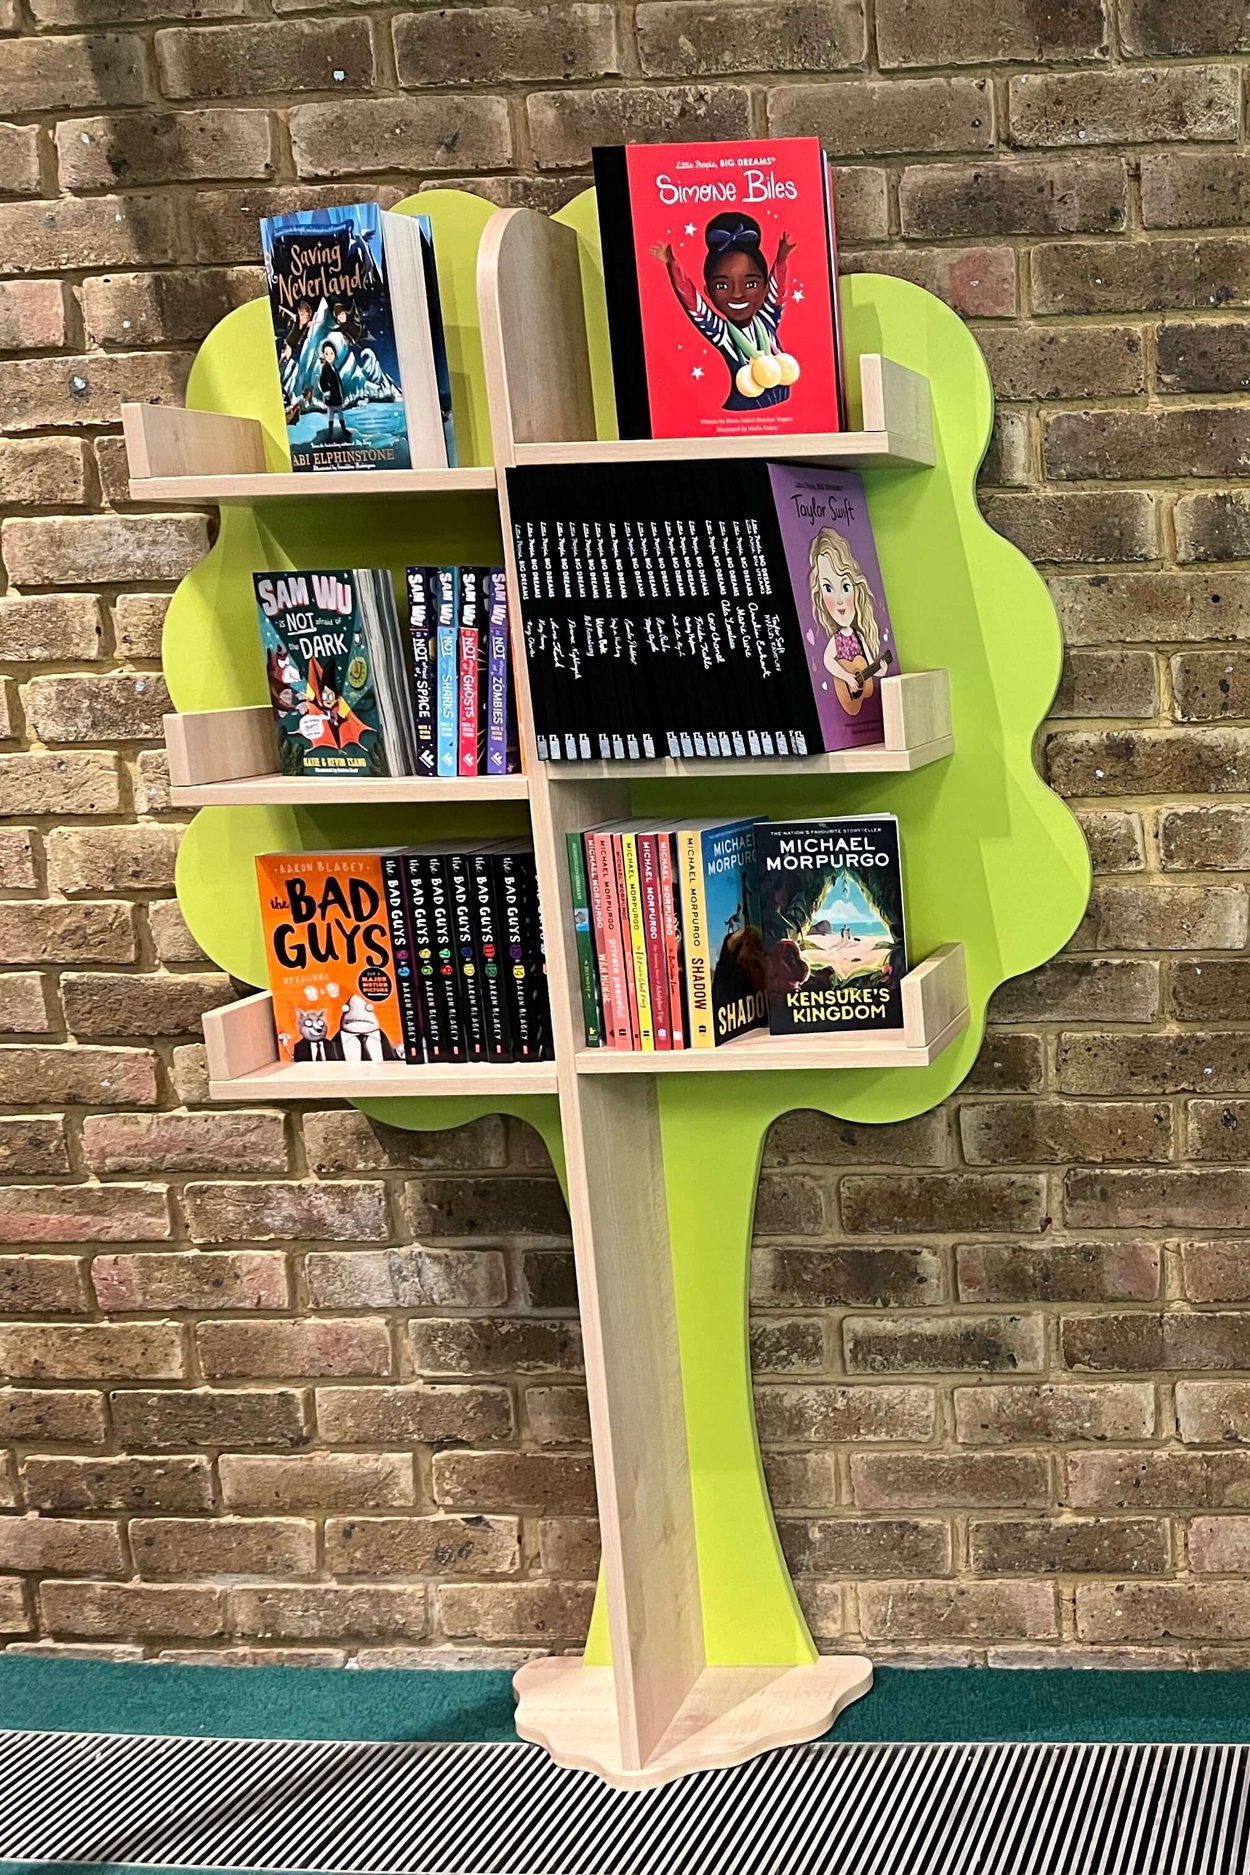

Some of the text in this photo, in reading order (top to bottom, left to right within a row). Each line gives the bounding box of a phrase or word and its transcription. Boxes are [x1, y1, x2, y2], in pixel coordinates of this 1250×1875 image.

[720, 158, 734, 167] BIG
[656, 170, 798, 205] Simone Biles
[290, 243, 343, 277] Saving
[279, 263, 363, 306] Neverland
[292, 449, 394, 466] ABI ELPHINSTONE
[791, 494, 854, 526] Taylor Swift
[258, 574, 352, 616] SAM WU
[408, 574, 426, 626] SAM WU
[462, 573, 476, 626] SAM WU
[491, 573, 506, 625] SAM WU
[286, 612, 316, 633] NOT
[736, 606, 752, 658] Marie Curie
[300, 632, 349, 660] DARK
[414, 638, 431, 718] NOT SPACE
[463, 637, 476, 718] NOT GHOSTS
[492, 636, 505, 724] NOT ZOMBIES
[280, 862, 364, 873] AARON BLABEY
[767, 853, 890, 870] MORPURGO
[780, 837, 875, 854] MICHAEL
[271, 876, 380, 924] the BAD
[386, 861, 406, 945] the BAD GUYS
[430, 859, 449, 944] the BAD GUYS
[600, 840, 614, 930] MICHAEL MORPURGO
[274, 918, 390, 970] GUYS
[687, 837, 707, 1010] MICHAEL MORPURGO SHADOW
[608, 939, 625, 1017] private peaceful
[786, 988, 890, 1007] KENSUKE'S
[402, 982, 416, 1042] AARON BLABEY
[718, 990, 767, 1035] SHADO
[793, 1004, 886, 1023] KINGDOM
